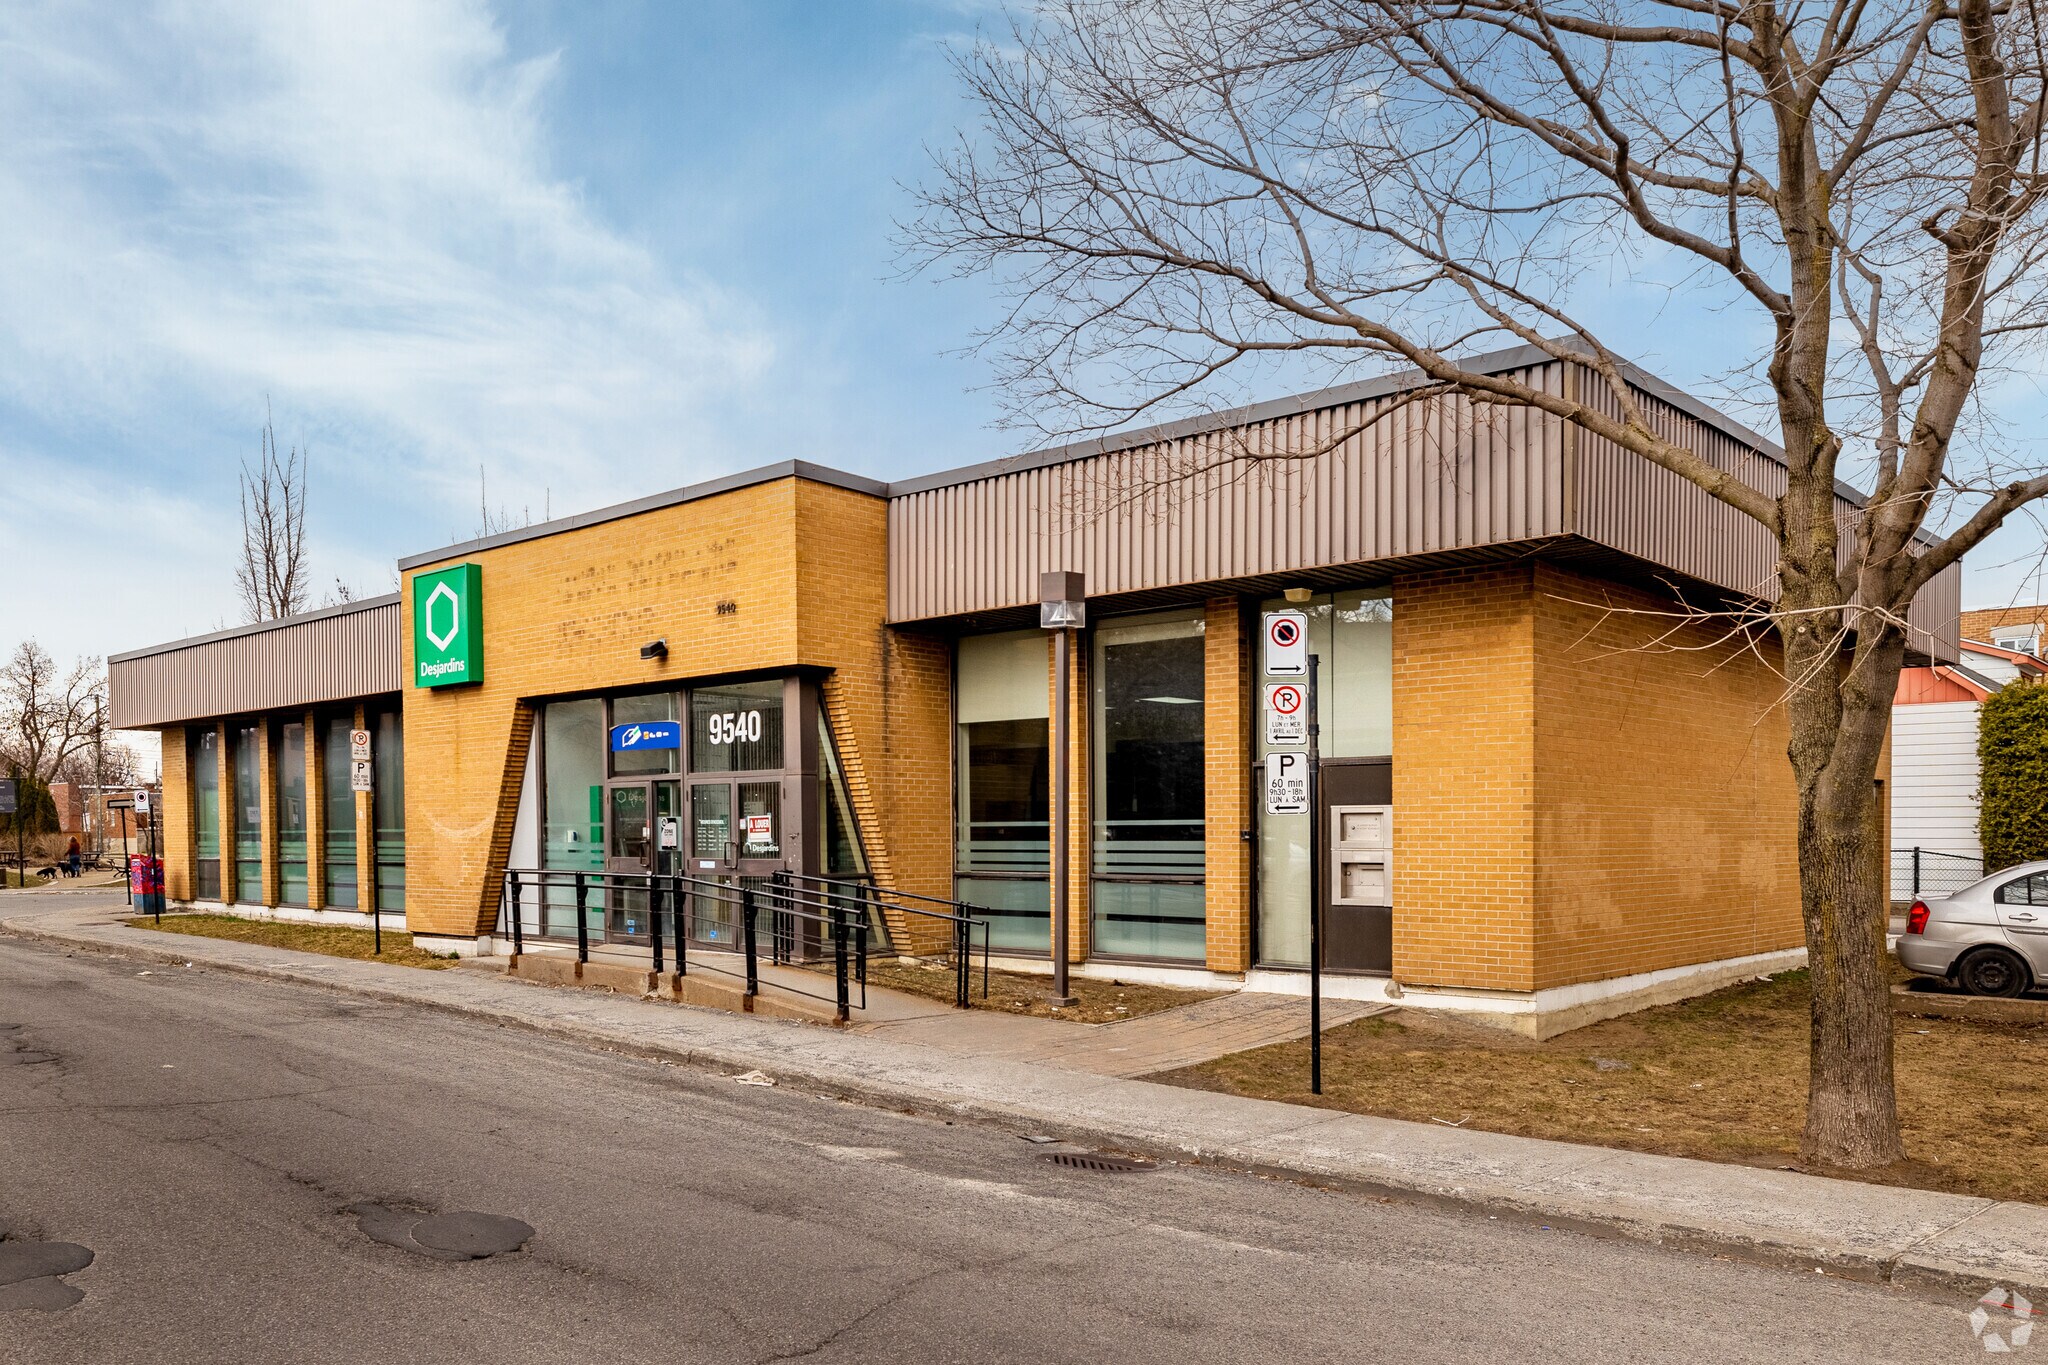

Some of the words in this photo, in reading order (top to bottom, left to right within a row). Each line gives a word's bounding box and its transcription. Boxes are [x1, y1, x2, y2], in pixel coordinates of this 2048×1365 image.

[717, 603, 736, 615] 9540
[420, 657, 465, 678] Desjardins
[709, 710, 761, 745] 9540
[1280, 755, 1294, 776] P
[1271, 778, 1283, 788] 60
[1287, 778, 1303, 788] min
[1269, 788, 1286, 796] 9h30
[1292, 788, 1303, 796] 18h
[1269, 796, 1282, 804] LUN
[752, 844, 779, 853] Desjardins
